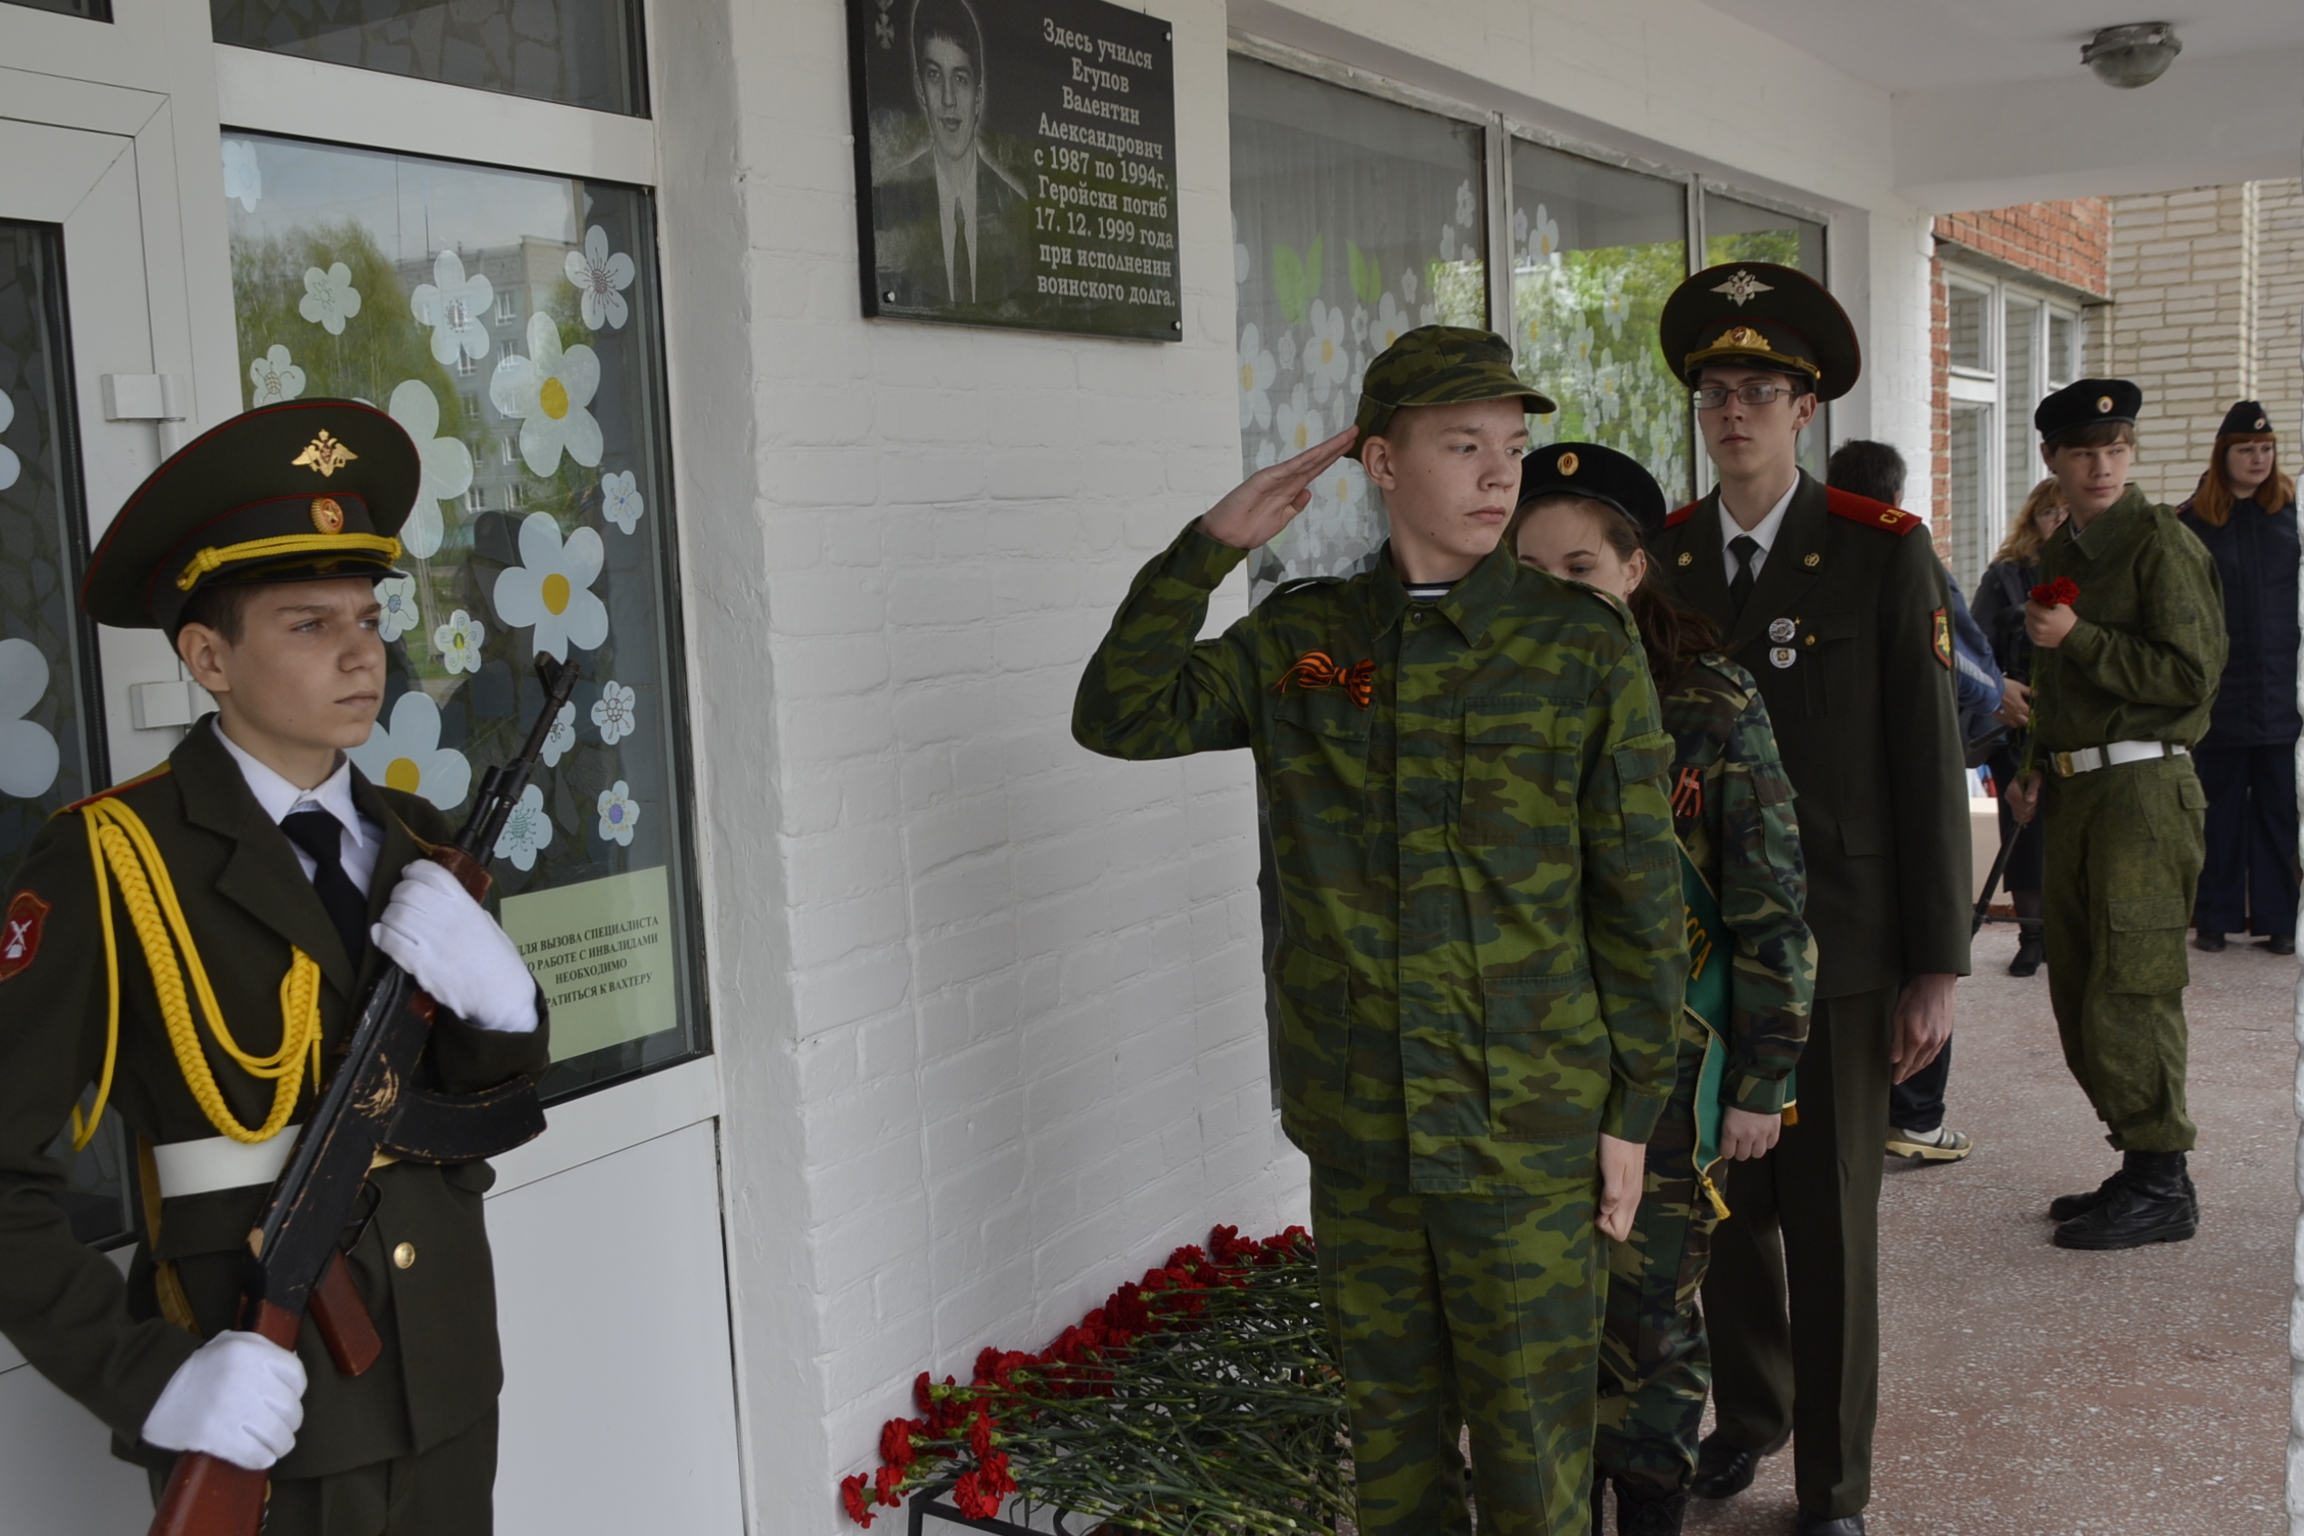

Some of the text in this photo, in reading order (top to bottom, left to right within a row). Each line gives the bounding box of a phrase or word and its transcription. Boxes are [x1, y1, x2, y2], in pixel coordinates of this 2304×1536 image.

[1043, 17, 1153, 70] Здесь учился
[1071, 56, 1130, 93] Егупов
[1062, 85, 1140, 126] Валентин
[1038, 111, 1163, 160] Александрович
[1034, 145, 1169, 191] с 1987 по 1994г.
[1038, 174, 1167, 219] Геройски погиб
[1035, 206, 1174, 249] 17. 12. 1999 года
[1039, 244, 1172, 278] при исполнении
[1037, 275, 1176, 307] воинского долга.
[537, 951, 578, 971] РАБОТЕ
[579, 949, 587, 961] С
[588, 932, 658, 959] ИНВАЛИДАМИ
[540, 933, 582, 952] ВЫЗОВА
[584, 916, 659, 942] СПЕЦИАЛИСТА
[546, 971, 653, 1007] РАТИТЬСЯ К ВАХТЕРУ
[555, 957, 628, 985] НЕОБХОДИМО
